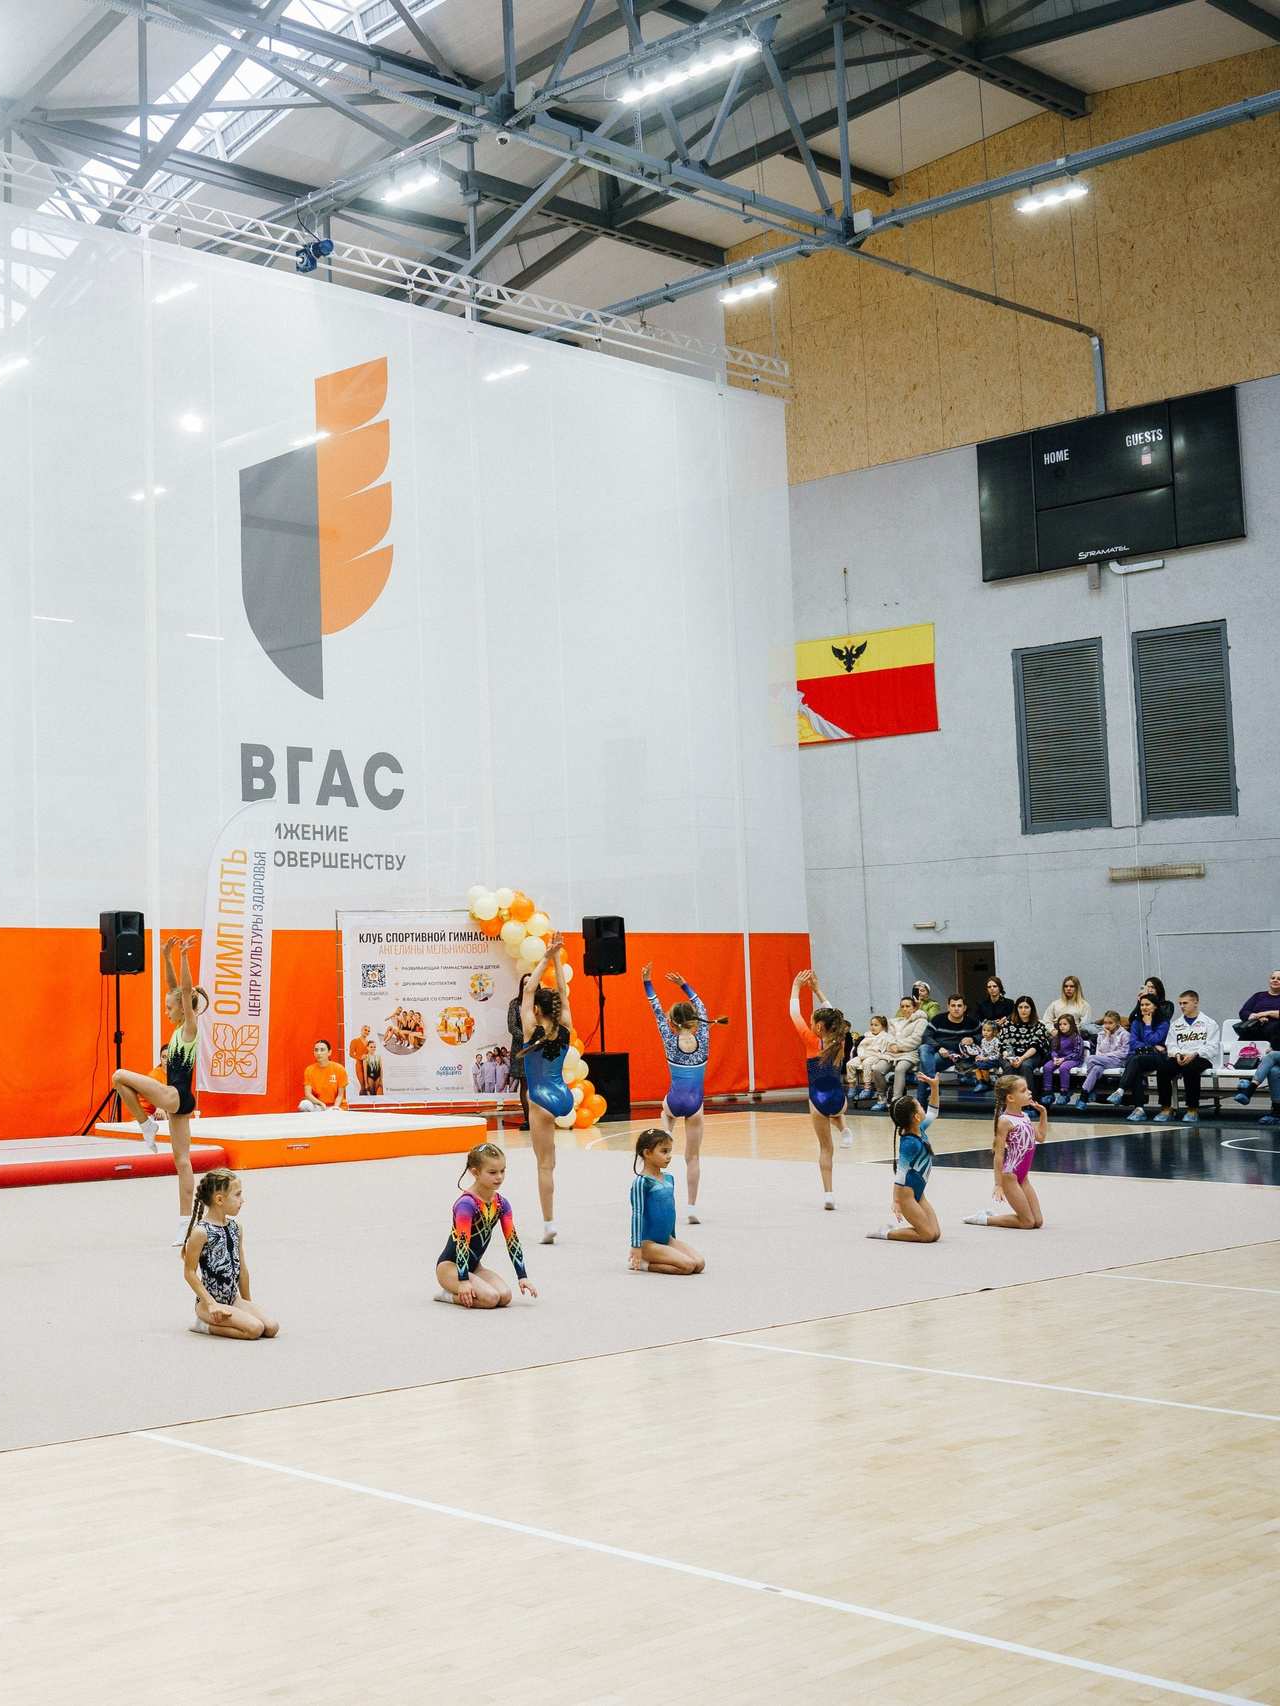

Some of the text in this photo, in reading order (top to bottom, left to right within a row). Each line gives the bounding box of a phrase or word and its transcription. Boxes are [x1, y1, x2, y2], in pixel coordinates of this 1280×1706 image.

[1044, 429, 1163, 465] HOME GUESTS
[1078, 545, 1129, 560] STRAMATEL
[241, 743, 404, 810] ВГАС
[274, 823, 348, 842] ИЖЕНИЕ
[274, 850, 406, 870] ОВЕРШЕНСТВУ
[214, 849, 247, 1015] ОЛИМП ПЯТЬ
[248, 851, 266, 1017] ЦЕНТР КУЛЬТУРЫ ЗДОРОВЬЯ
[359, 933, 383, 944] КЛУБ
[386, 930, 446, 943] СПОРТИВНОЙ
[379, 942, 489, 955] АНГЕЛИНЫ МЕЛЬНИКОВОЙ
